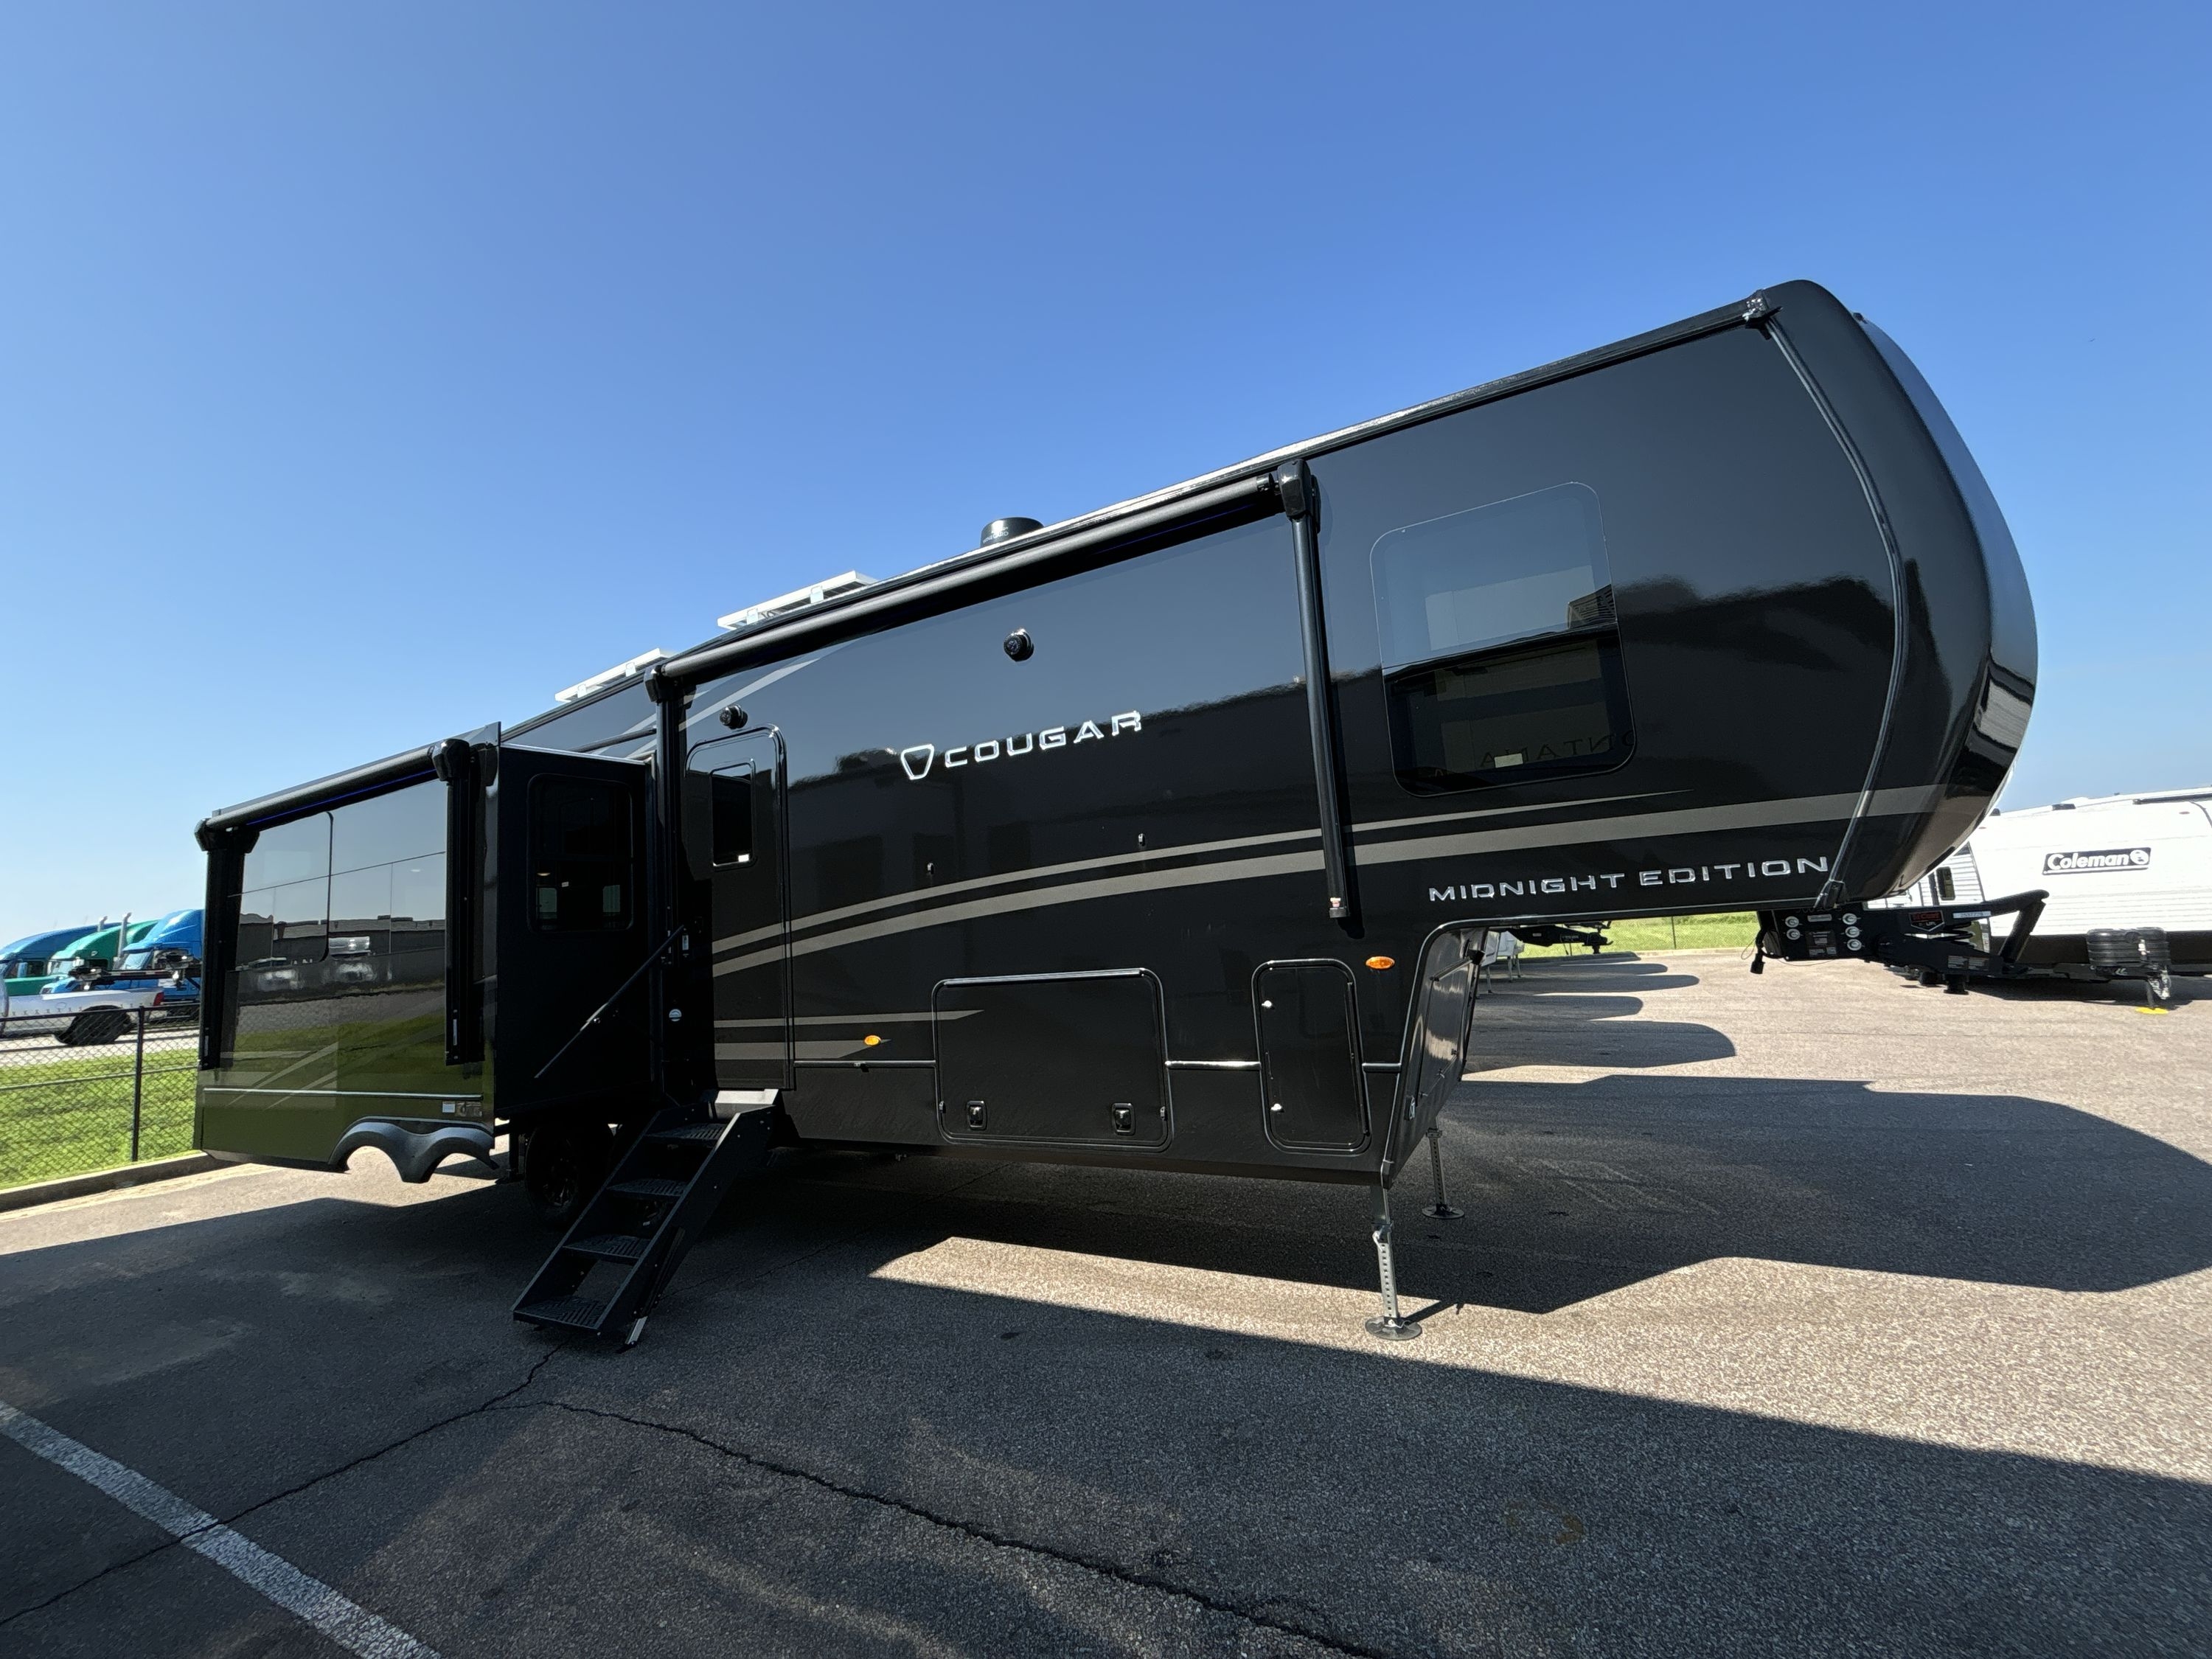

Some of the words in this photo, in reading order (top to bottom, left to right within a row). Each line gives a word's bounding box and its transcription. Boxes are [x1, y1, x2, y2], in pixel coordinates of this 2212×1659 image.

[945, 710, 1141, 768] COUGAR
[1429, 873, 1625, 902] MIDNIGHT
[1639, 856, 1829, 886] EDITION
[2047, 852, 2129, 871] Coleman
